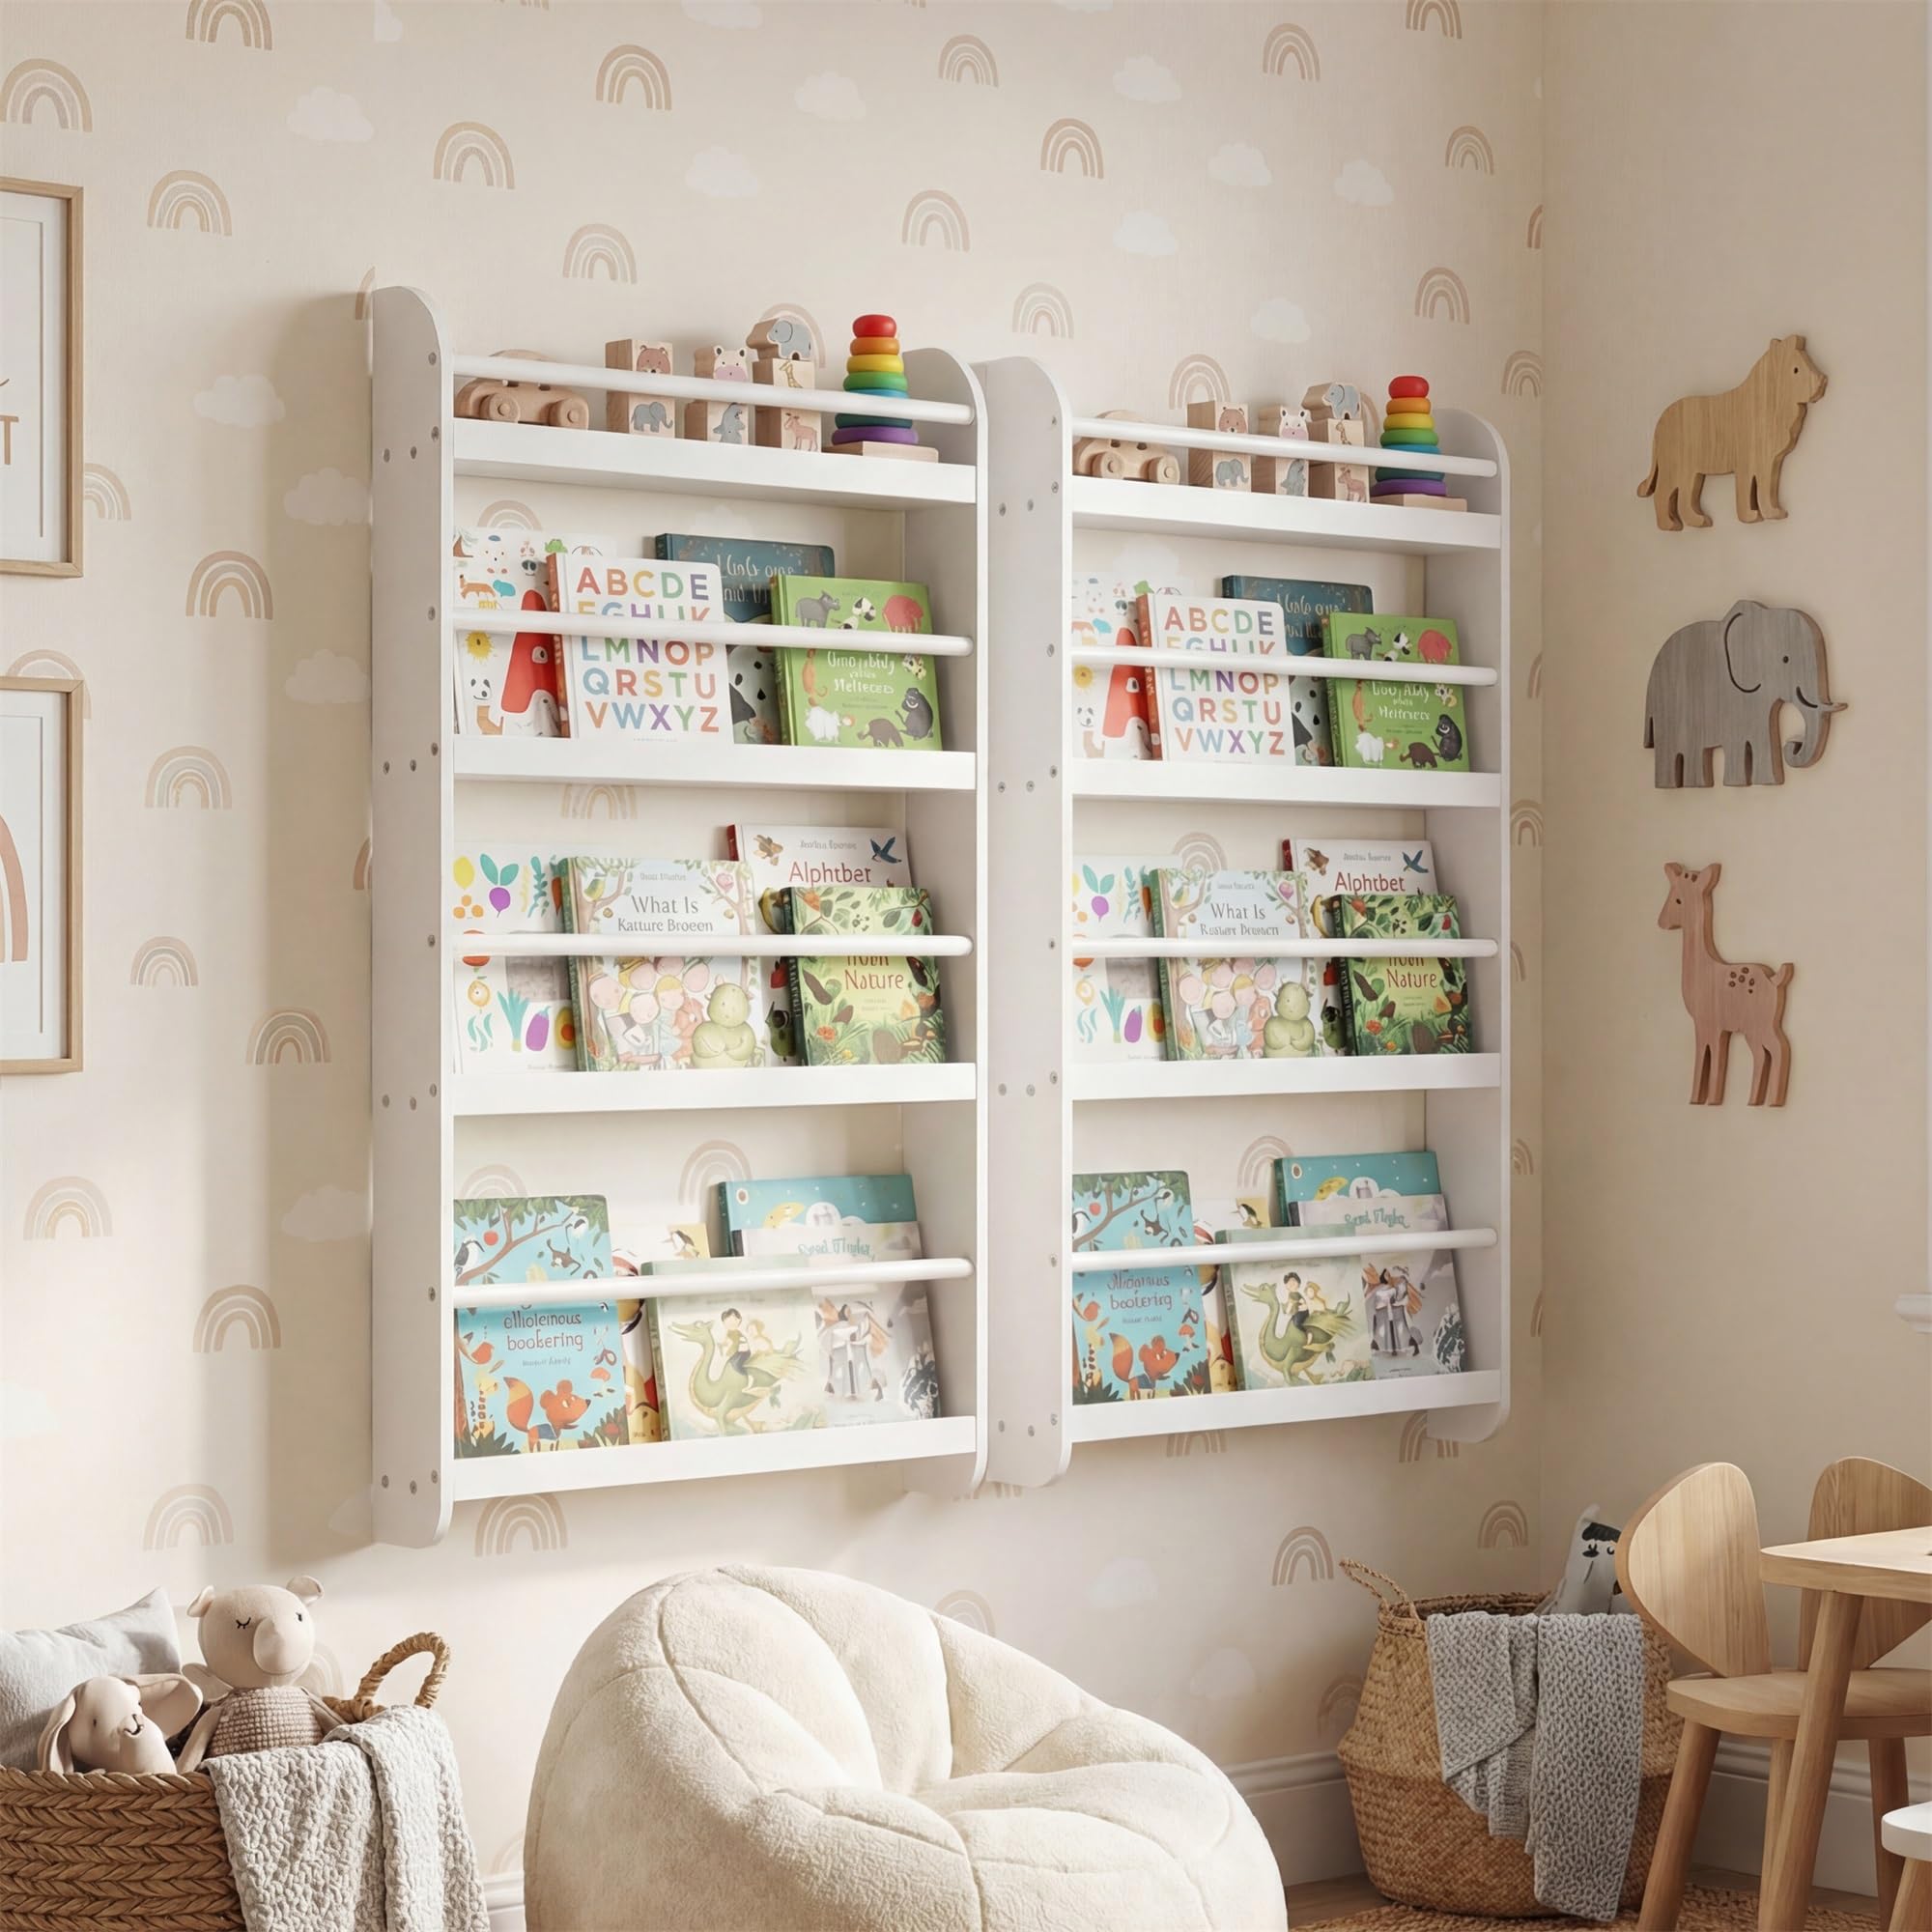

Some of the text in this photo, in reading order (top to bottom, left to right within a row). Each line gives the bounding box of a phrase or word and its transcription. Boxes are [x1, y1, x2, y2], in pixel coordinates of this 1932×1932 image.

[577, 567, 709, 601] ABCDE
[1164, 607, 1274, 636] ABCDE
[581, 636, 714, 666] LMNOP
[582, 668, 716, 699] QRSTU
[1170, 668, 1279, 695] LMNOP
[585, 701, 719, 733] VWXYZ
[1172, 696, 1281, 725] QRSTU
[1175, 726, 1285, 755] VWXYZ
[631, 895, 698, 914] What Is
[1210, 903, 1266, 920] What Is
[844, 969, 904, 990] Nature
[1386, 968, 1437, 988] Nature
